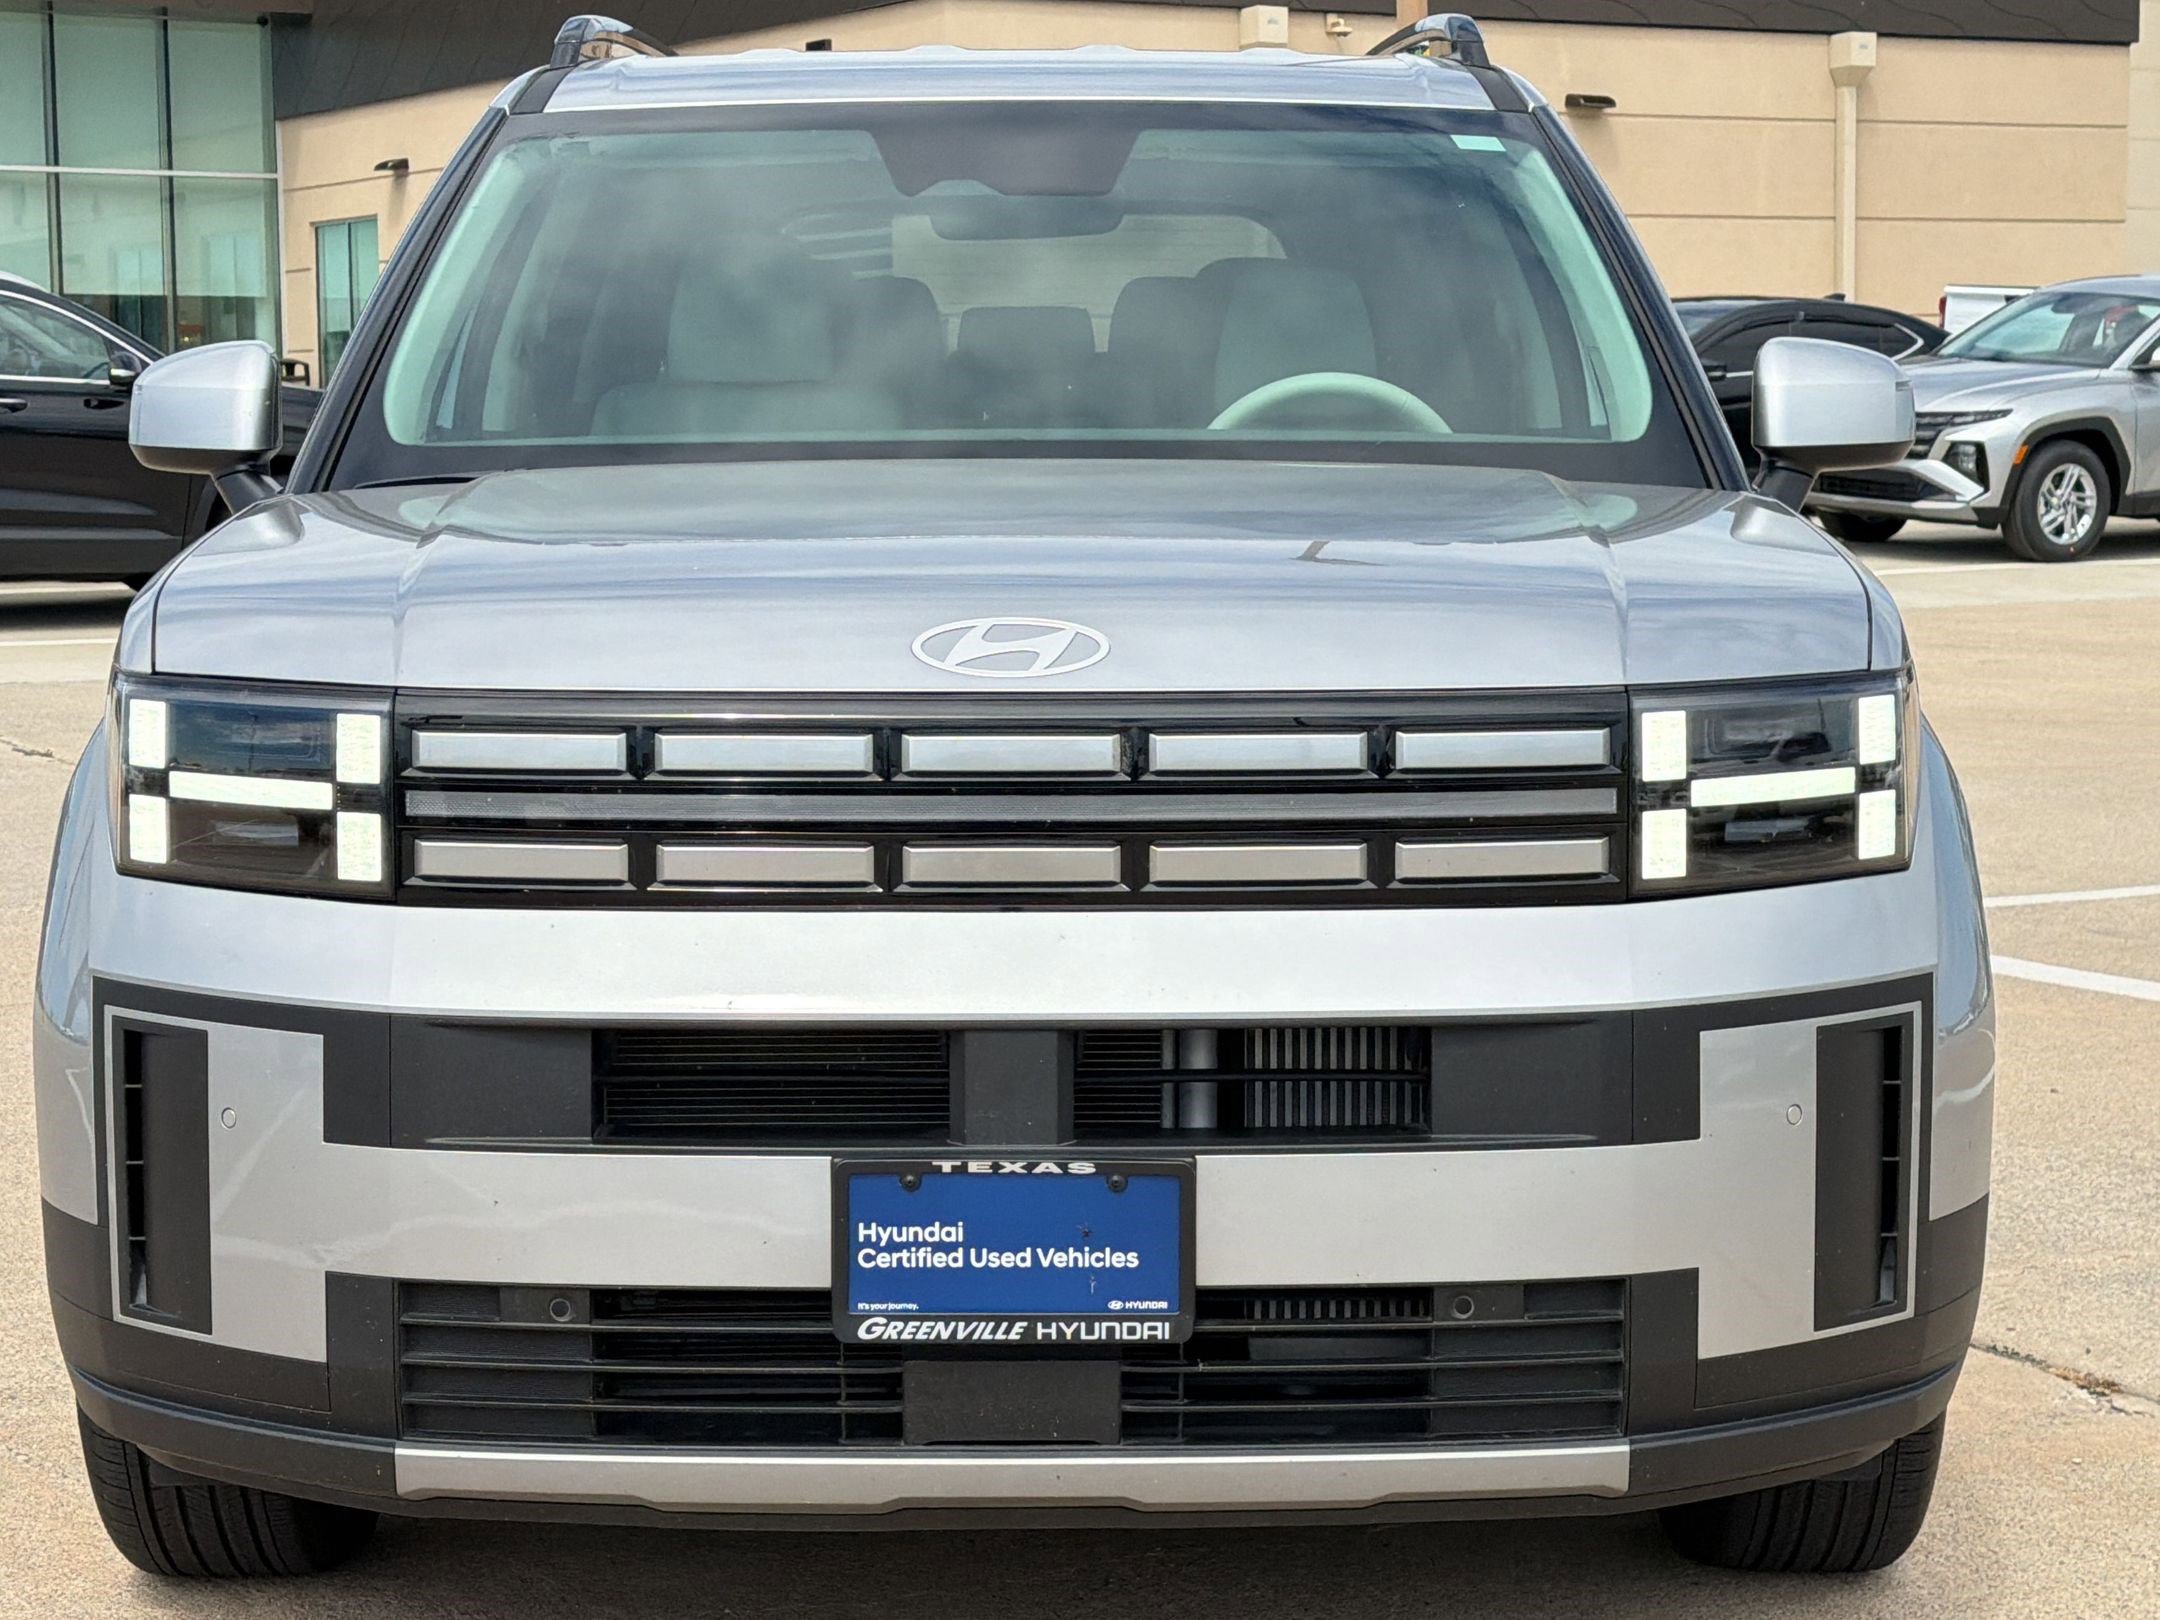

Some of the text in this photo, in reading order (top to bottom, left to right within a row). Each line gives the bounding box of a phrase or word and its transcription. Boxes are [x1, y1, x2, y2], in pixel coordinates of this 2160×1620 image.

[931, 1161, 1097, 1174] TEXAS
[857, 1221, 964, 1247] Hyundai
[857, 1246, 1139, 1268] Certified Used Vehicles
[870, 1303, 887, 1311] your
[1125, 1301, 1168, 1310] HYUNDAI
[857, 1316, 1170, 1340] GREENVILLE HYUNDAI
